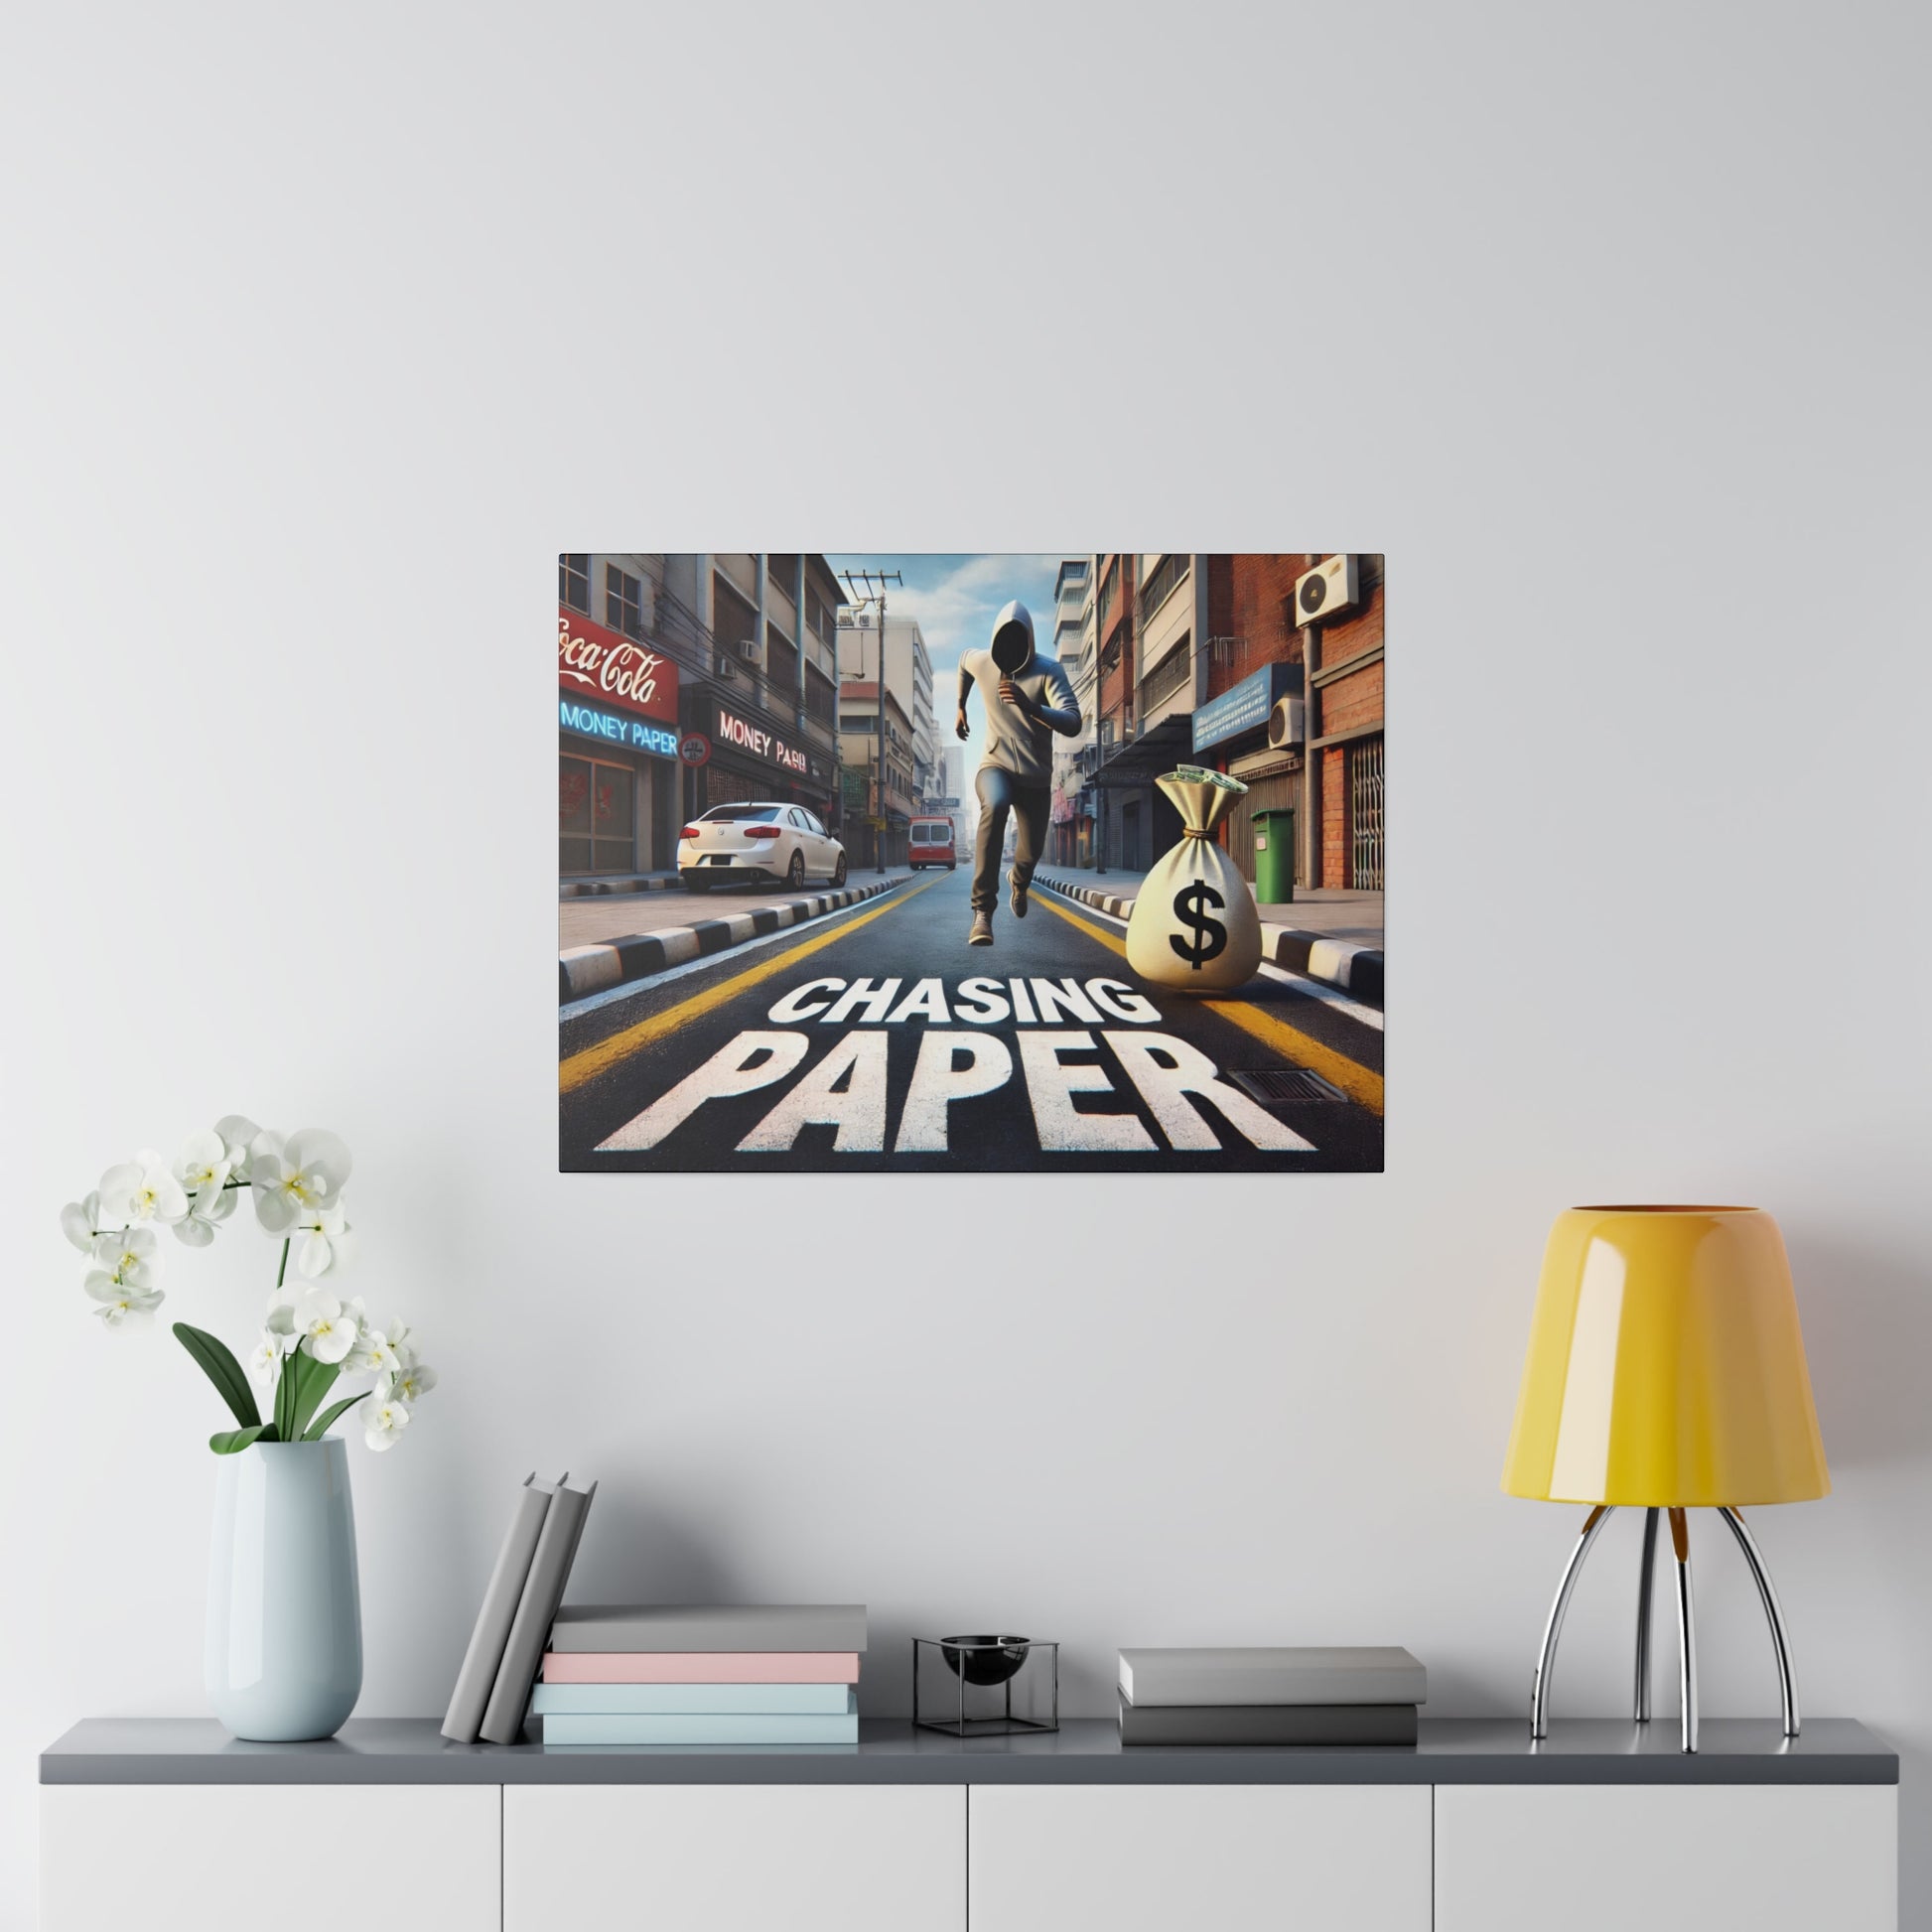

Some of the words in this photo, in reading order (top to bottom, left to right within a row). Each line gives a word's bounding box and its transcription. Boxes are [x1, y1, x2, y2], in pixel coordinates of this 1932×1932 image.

[560, 701, 627, 741] MONEY
[632, 723, 678, 756] PAPER
[720, 710, 771, 757] MONEY
[766, 977, 1162, 1024] CHASING
[593, 1031, 1318, 1153] PAPER
